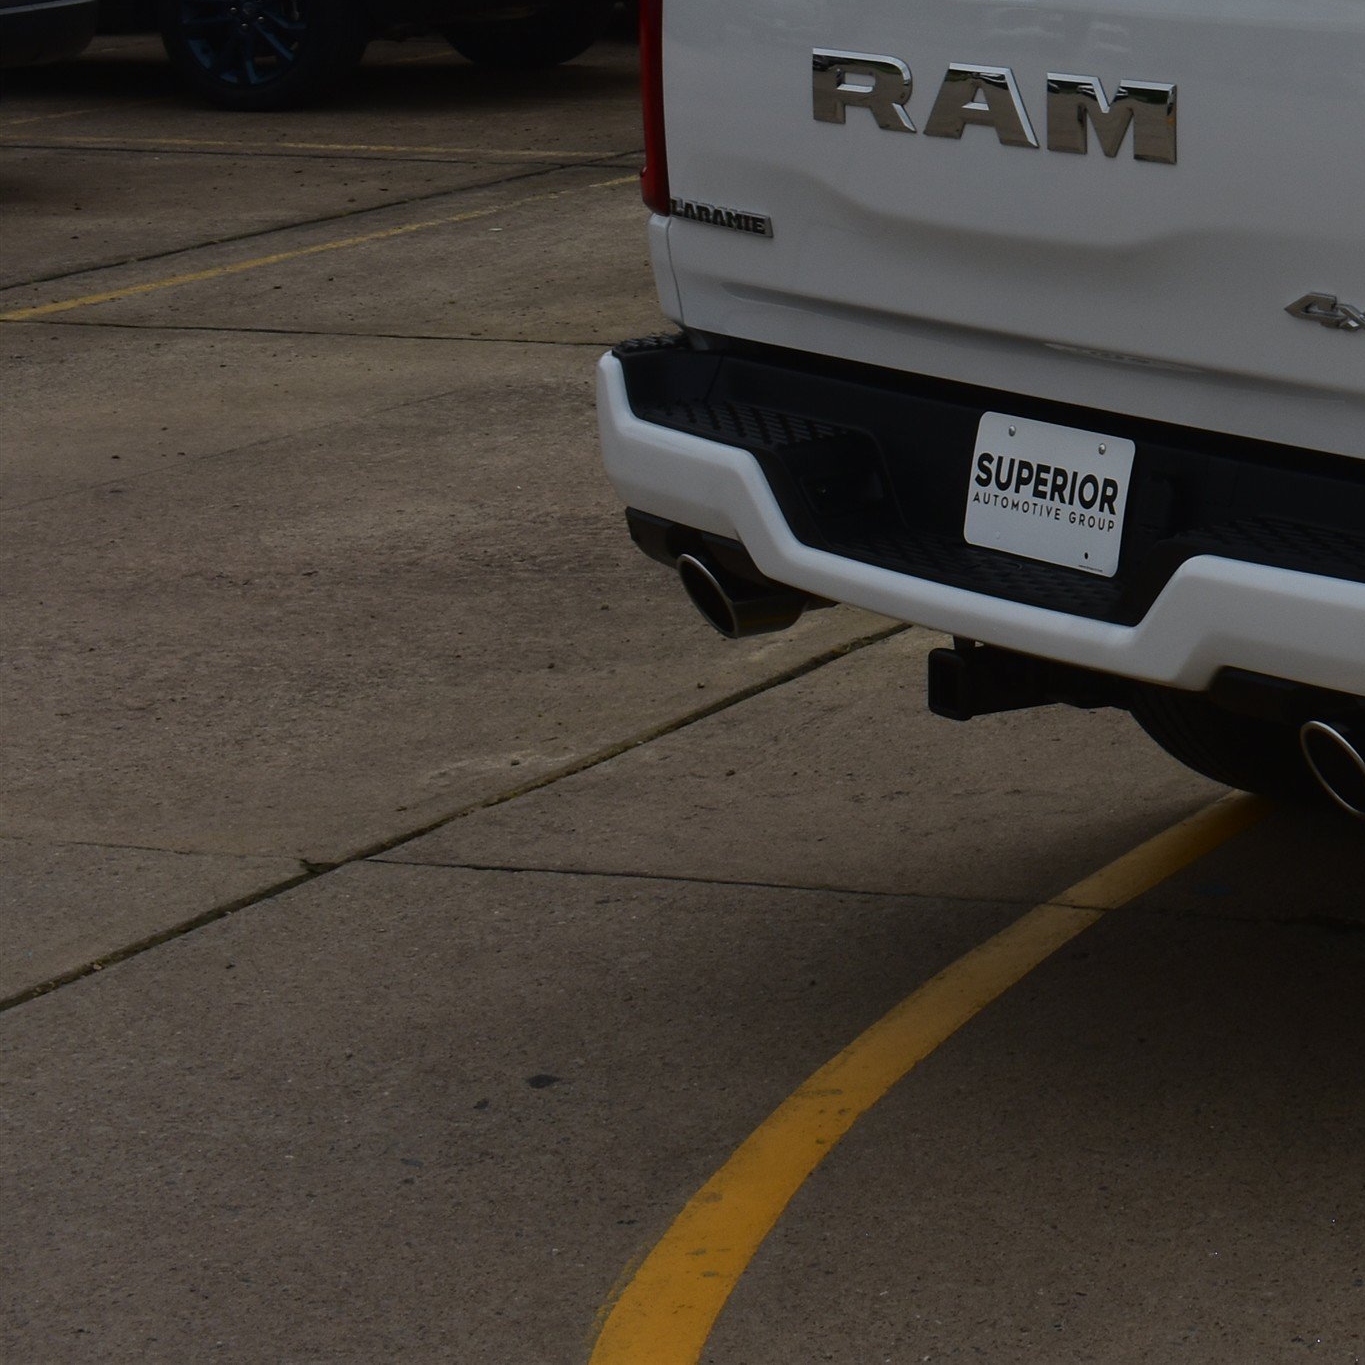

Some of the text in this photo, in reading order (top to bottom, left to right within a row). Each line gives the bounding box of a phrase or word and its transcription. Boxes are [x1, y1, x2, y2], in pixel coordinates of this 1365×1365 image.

[812, 47, 1178, 165] RAM
[671, 198, 768, 236] LARAMIE
[974, 452, 1119, 516] SUPERIOR
[972, 491, 1115, 533] AUTOMOTIVE GROUP
